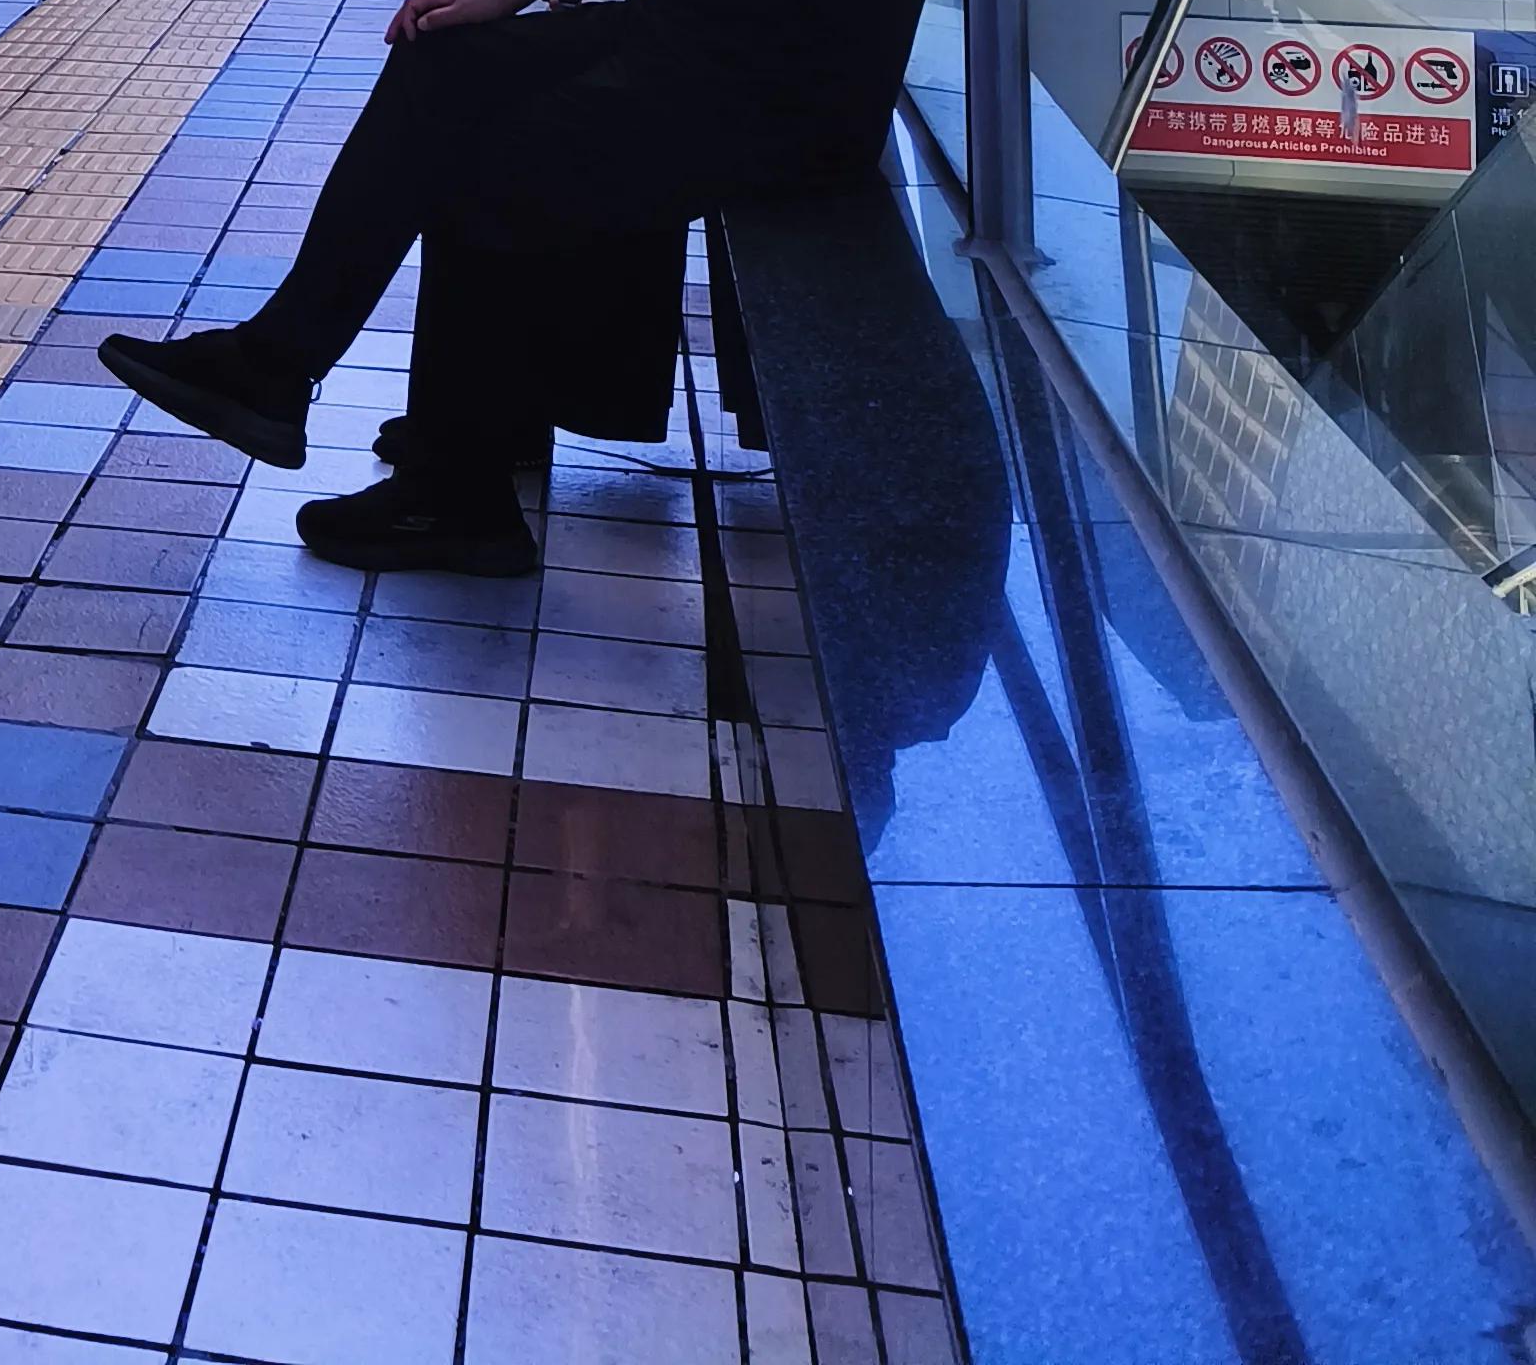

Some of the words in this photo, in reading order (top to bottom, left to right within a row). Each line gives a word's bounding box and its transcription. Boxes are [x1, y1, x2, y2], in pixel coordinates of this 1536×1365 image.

[1203, 135, 1268, 149] Dangerous
[1269, 139, 1317, 153] Articles
[1321, 143, 1387, 157] Prohibited
